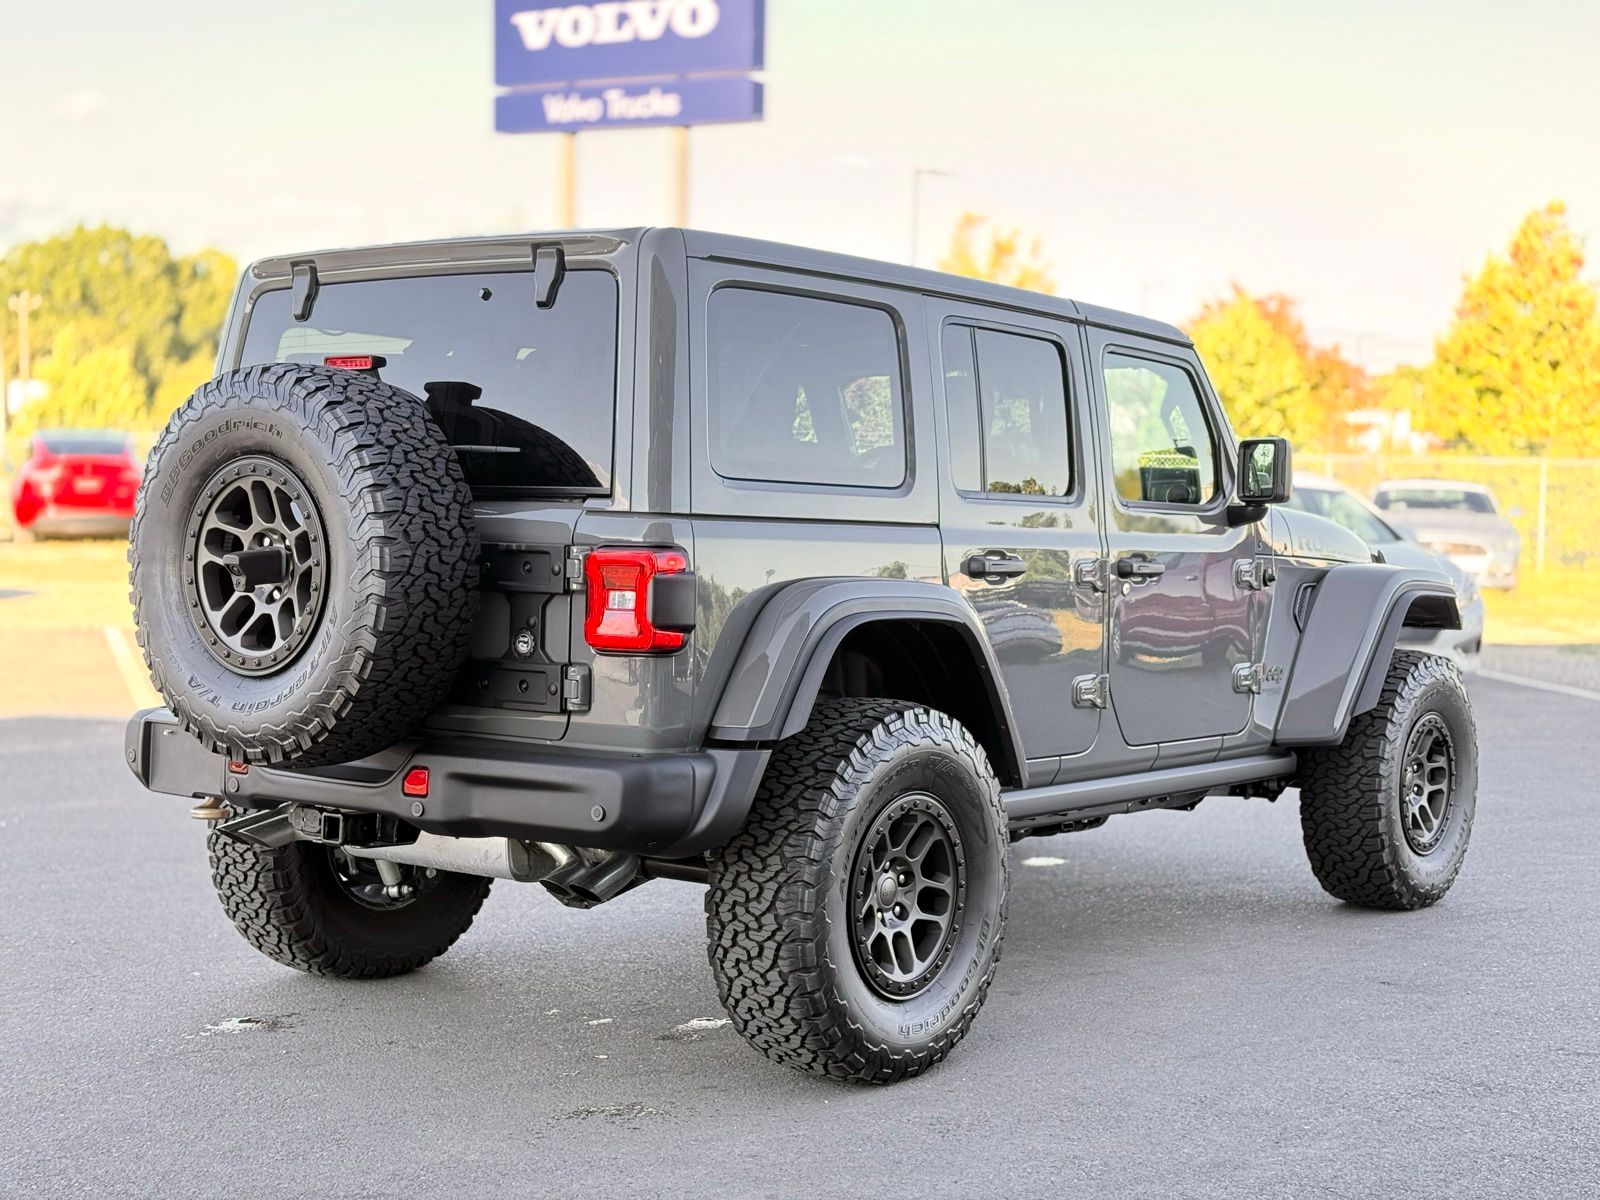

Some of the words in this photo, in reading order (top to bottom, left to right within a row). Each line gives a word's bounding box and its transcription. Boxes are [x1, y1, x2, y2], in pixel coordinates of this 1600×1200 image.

[510, 0, 720, 51] VOLVO
[602, 87, 682, 120] Trucks
[160, 417, 283, 508] BFGoodrich
[897, 916, 991, 1038] BFGoodrich
